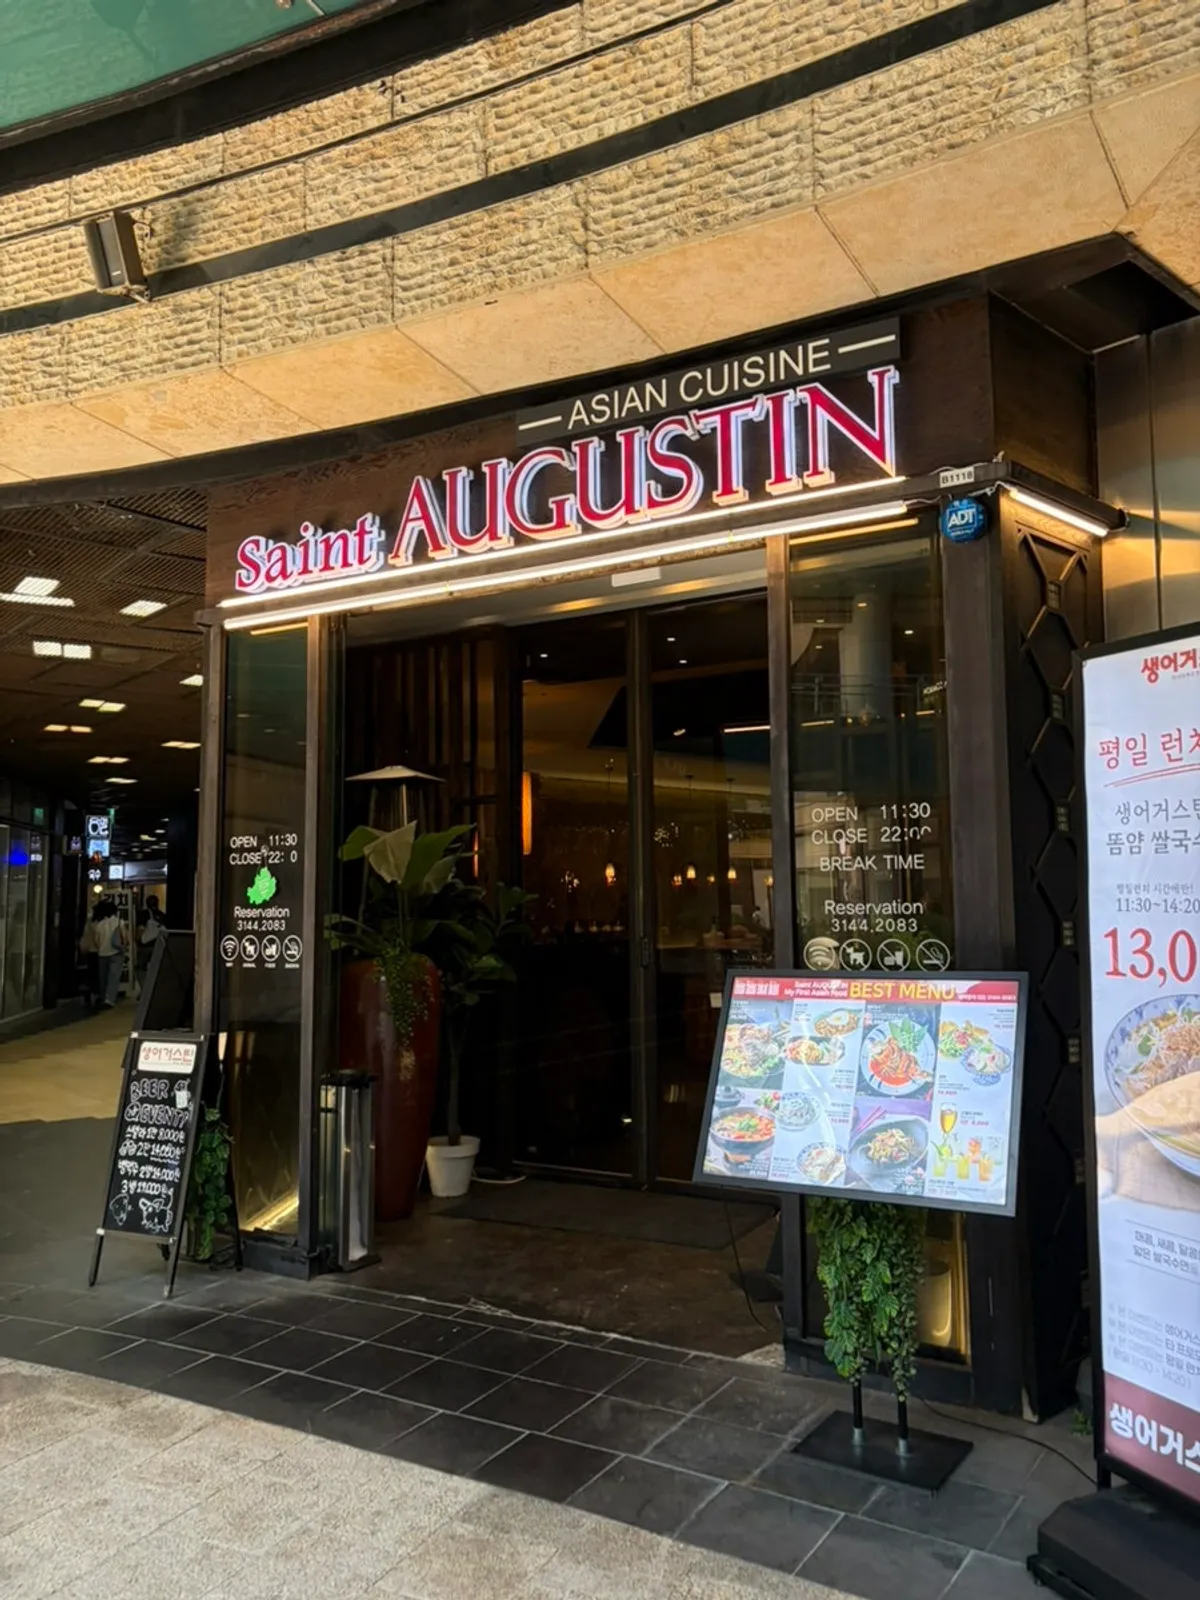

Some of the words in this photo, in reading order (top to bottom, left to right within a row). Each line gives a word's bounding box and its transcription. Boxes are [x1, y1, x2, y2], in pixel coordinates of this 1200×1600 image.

[567, 378, 668, 430] ASIAN
[679, 338, 832, 402] CUISINE
[235, 511, 385, 594] Saint
[388, 364, 900, 566] AUGUSTIN
[947, 508, 977, 528] ADT
[1099, 732, 1148, 770] 평일
[811, 806, 859, 823] OPEN
[880, 802, 931, 819] 11:30
[229, 835, 258, 849] OPEN
[269, 833, 298, 847] 11:30
[811, 827, 868, 845] CLOSE
[229, 852, 262, 865] CLOSE
[820, 855, 878, 871] BREAK
[883, 854, 925, 870] TIME
[234, 906, 290, 918] Reservation
[824, 899, 924, 915] Reservation
[831, 918, 918, 933] 3144.2083
[850, 982, 895, 998] BEST
[900, 983, 956, 1000] MENU
[130, 1078, 170, 1102] BEER
